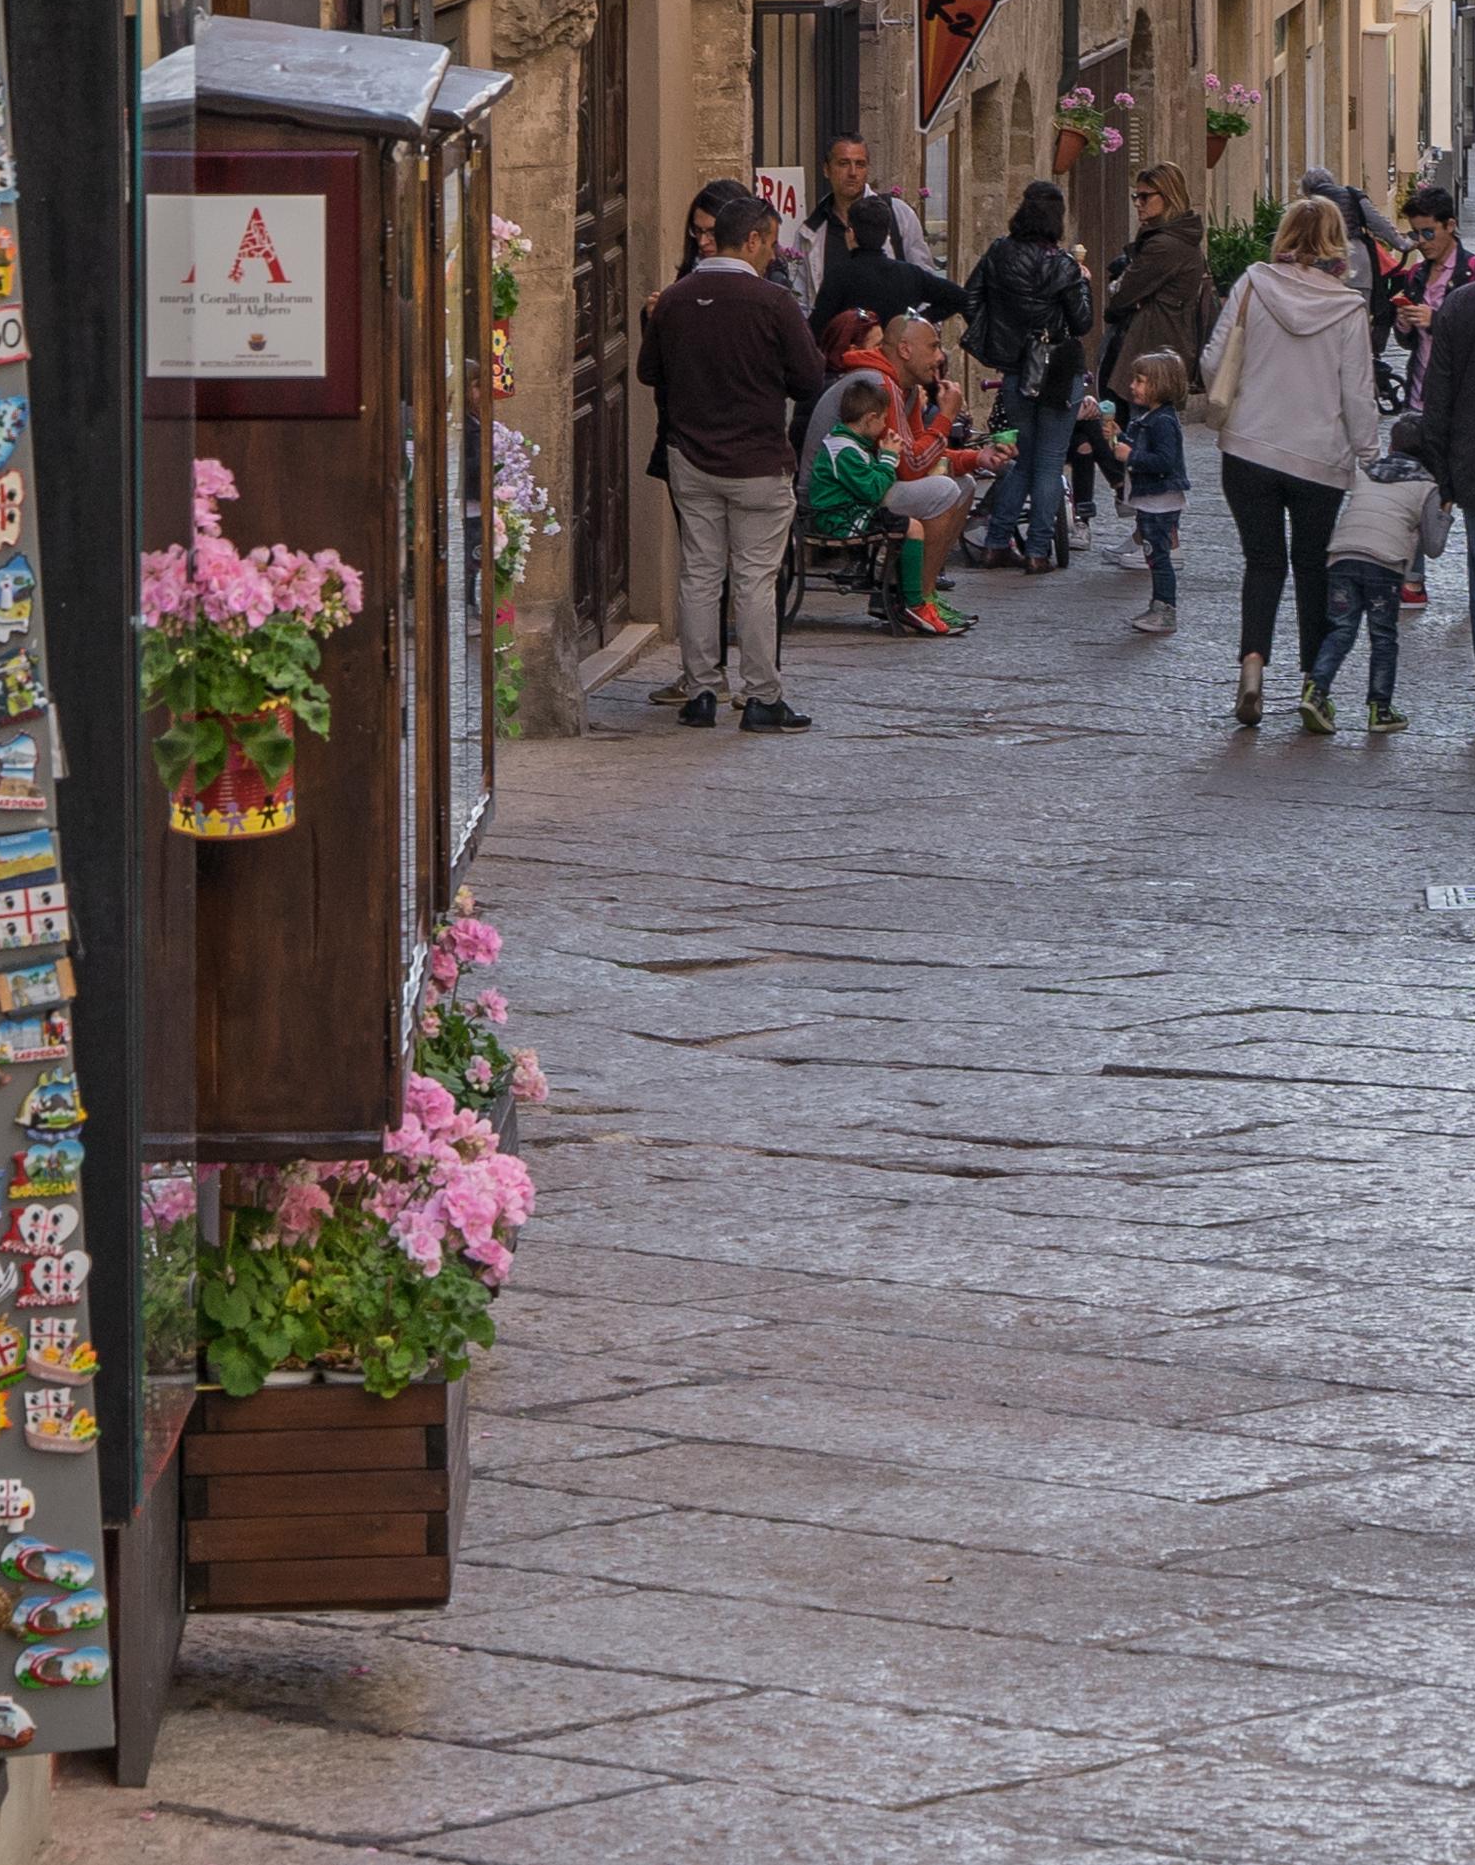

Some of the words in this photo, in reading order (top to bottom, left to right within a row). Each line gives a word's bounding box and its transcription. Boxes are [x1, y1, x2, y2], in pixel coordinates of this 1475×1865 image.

[756, 175, 796, 219] RIA
[200, 292, 259, 304] Corallium
[264, 292, 313, 304] Rubrum
[226, 305, 241, 316] ad
[244, 305, 291, 319] Alghero
